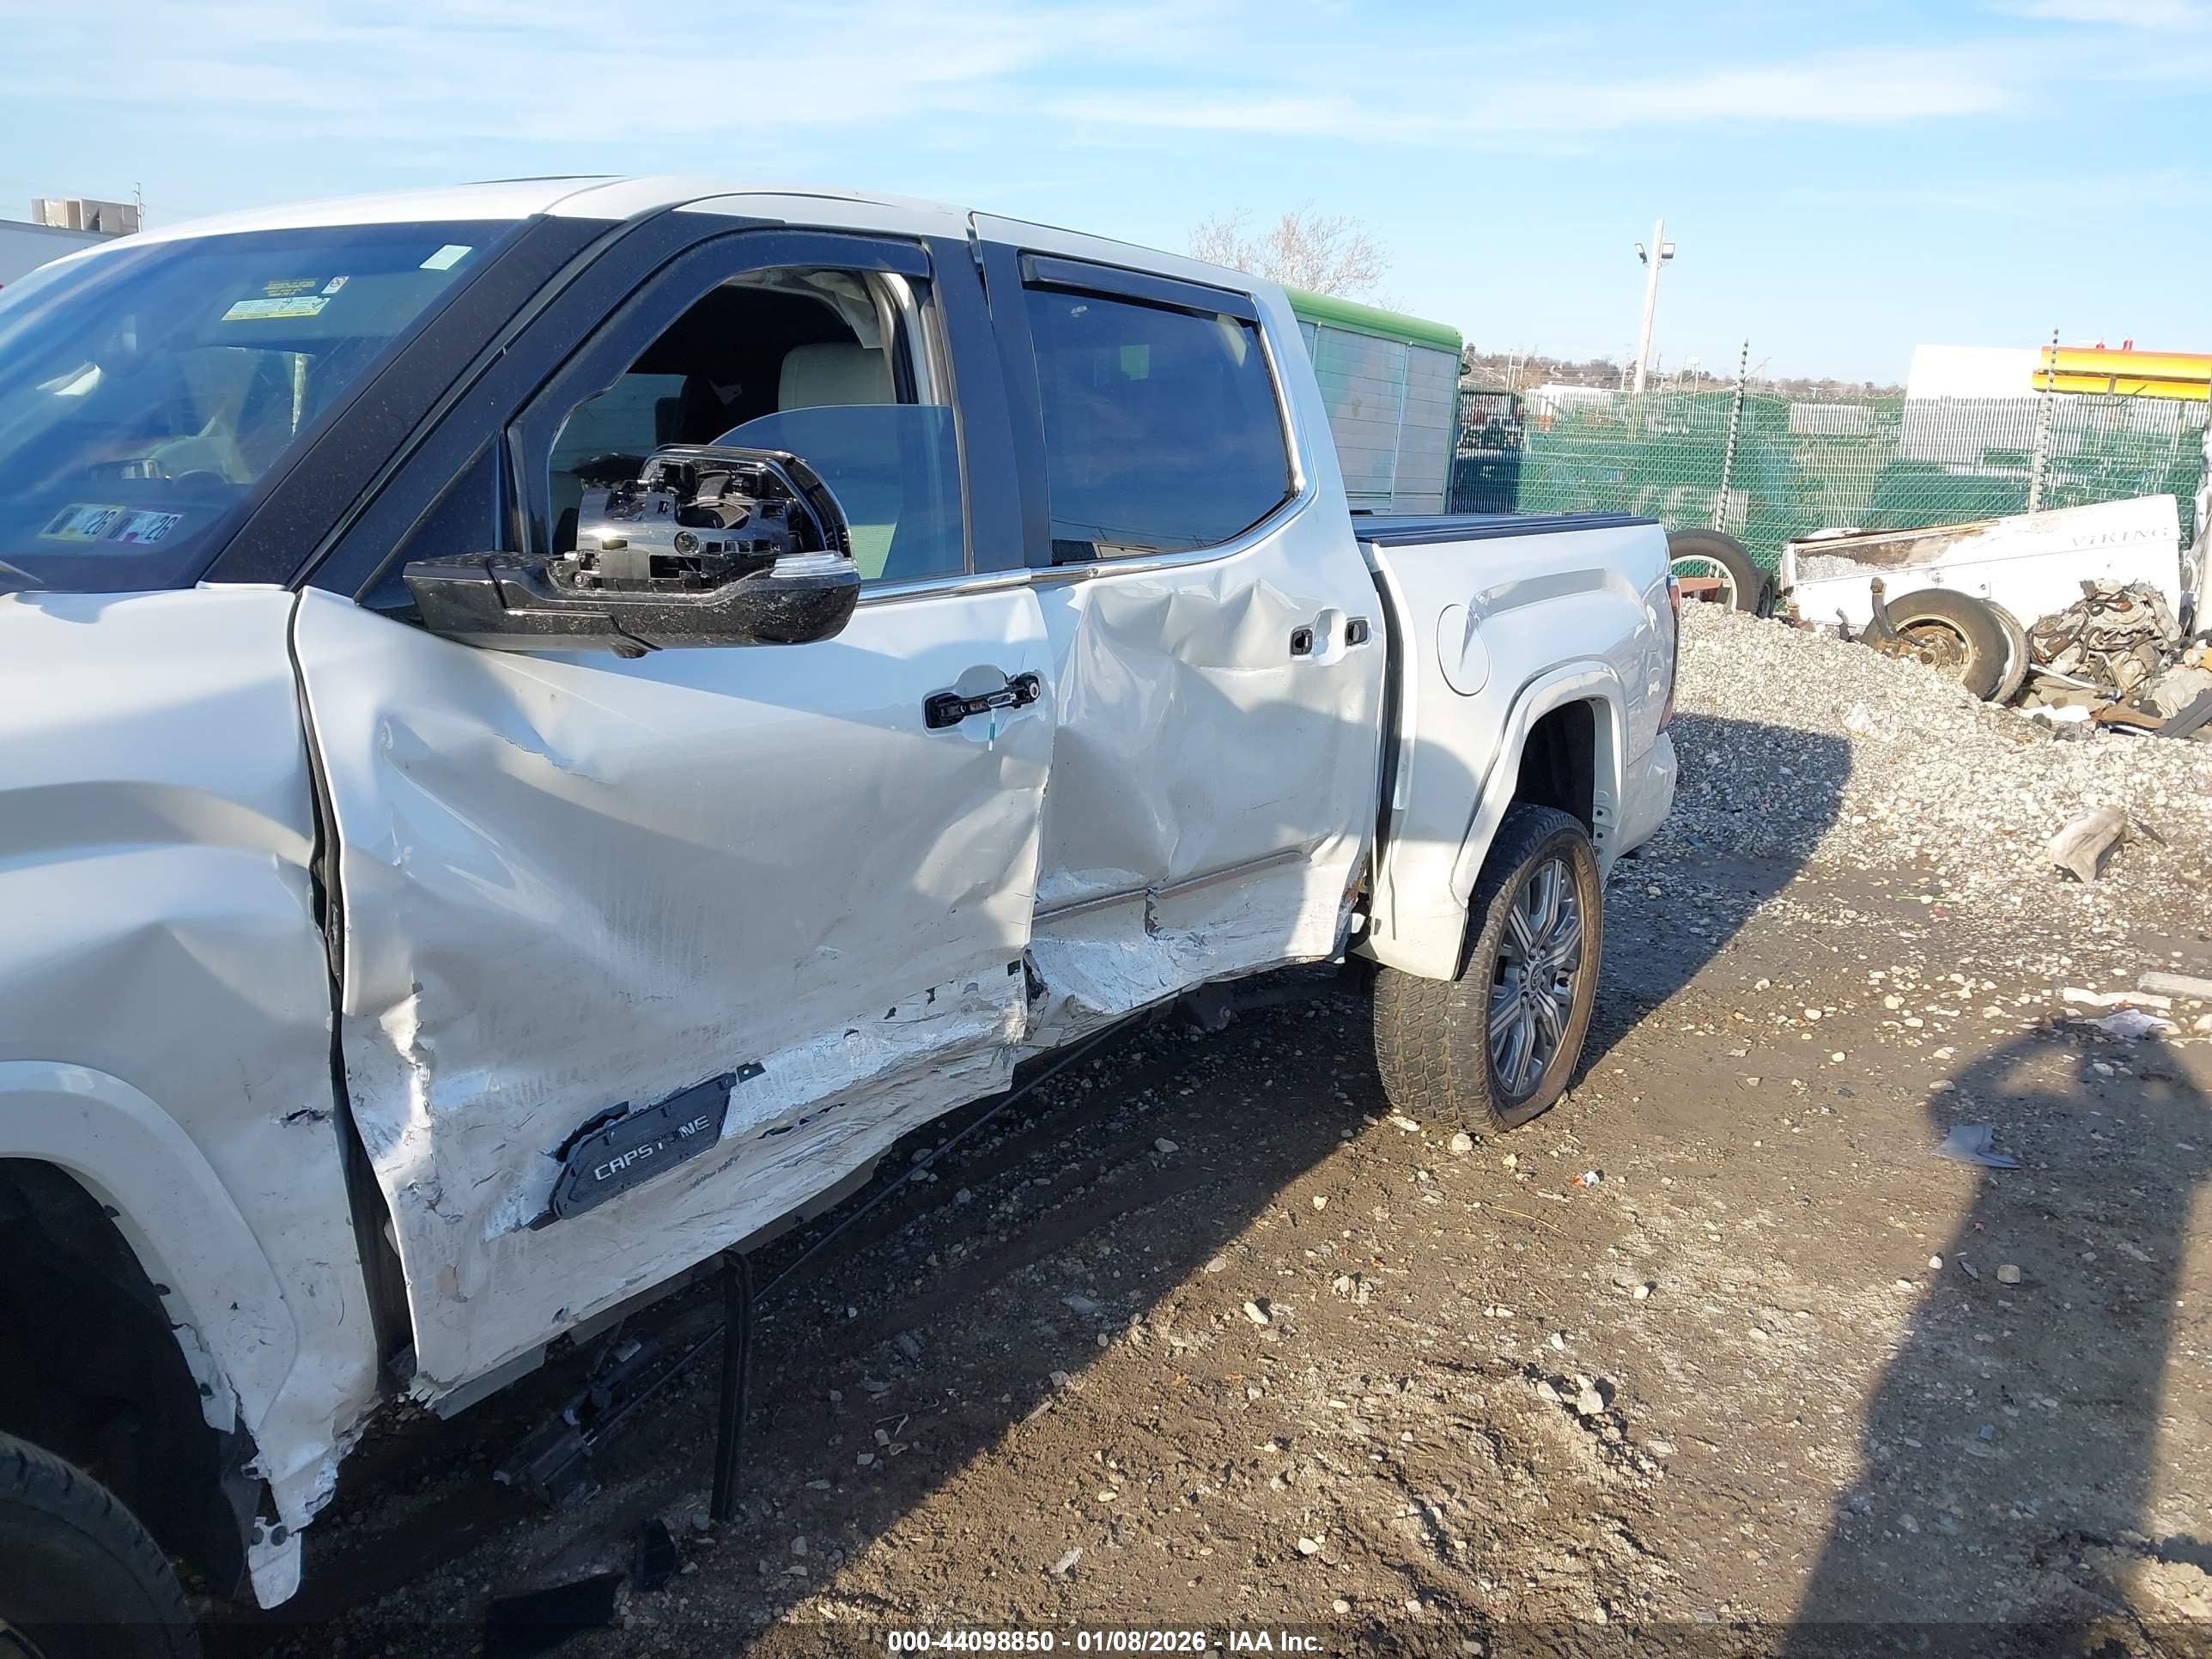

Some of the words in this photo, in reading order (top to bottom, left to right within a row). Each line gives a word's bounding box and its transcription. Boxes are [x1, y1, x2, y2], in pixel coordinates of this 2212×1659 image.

[83, 510, 118, 535] 26
[144, 515, 179, 541] 26
[2070, 526, 2168, 547] VIKING
